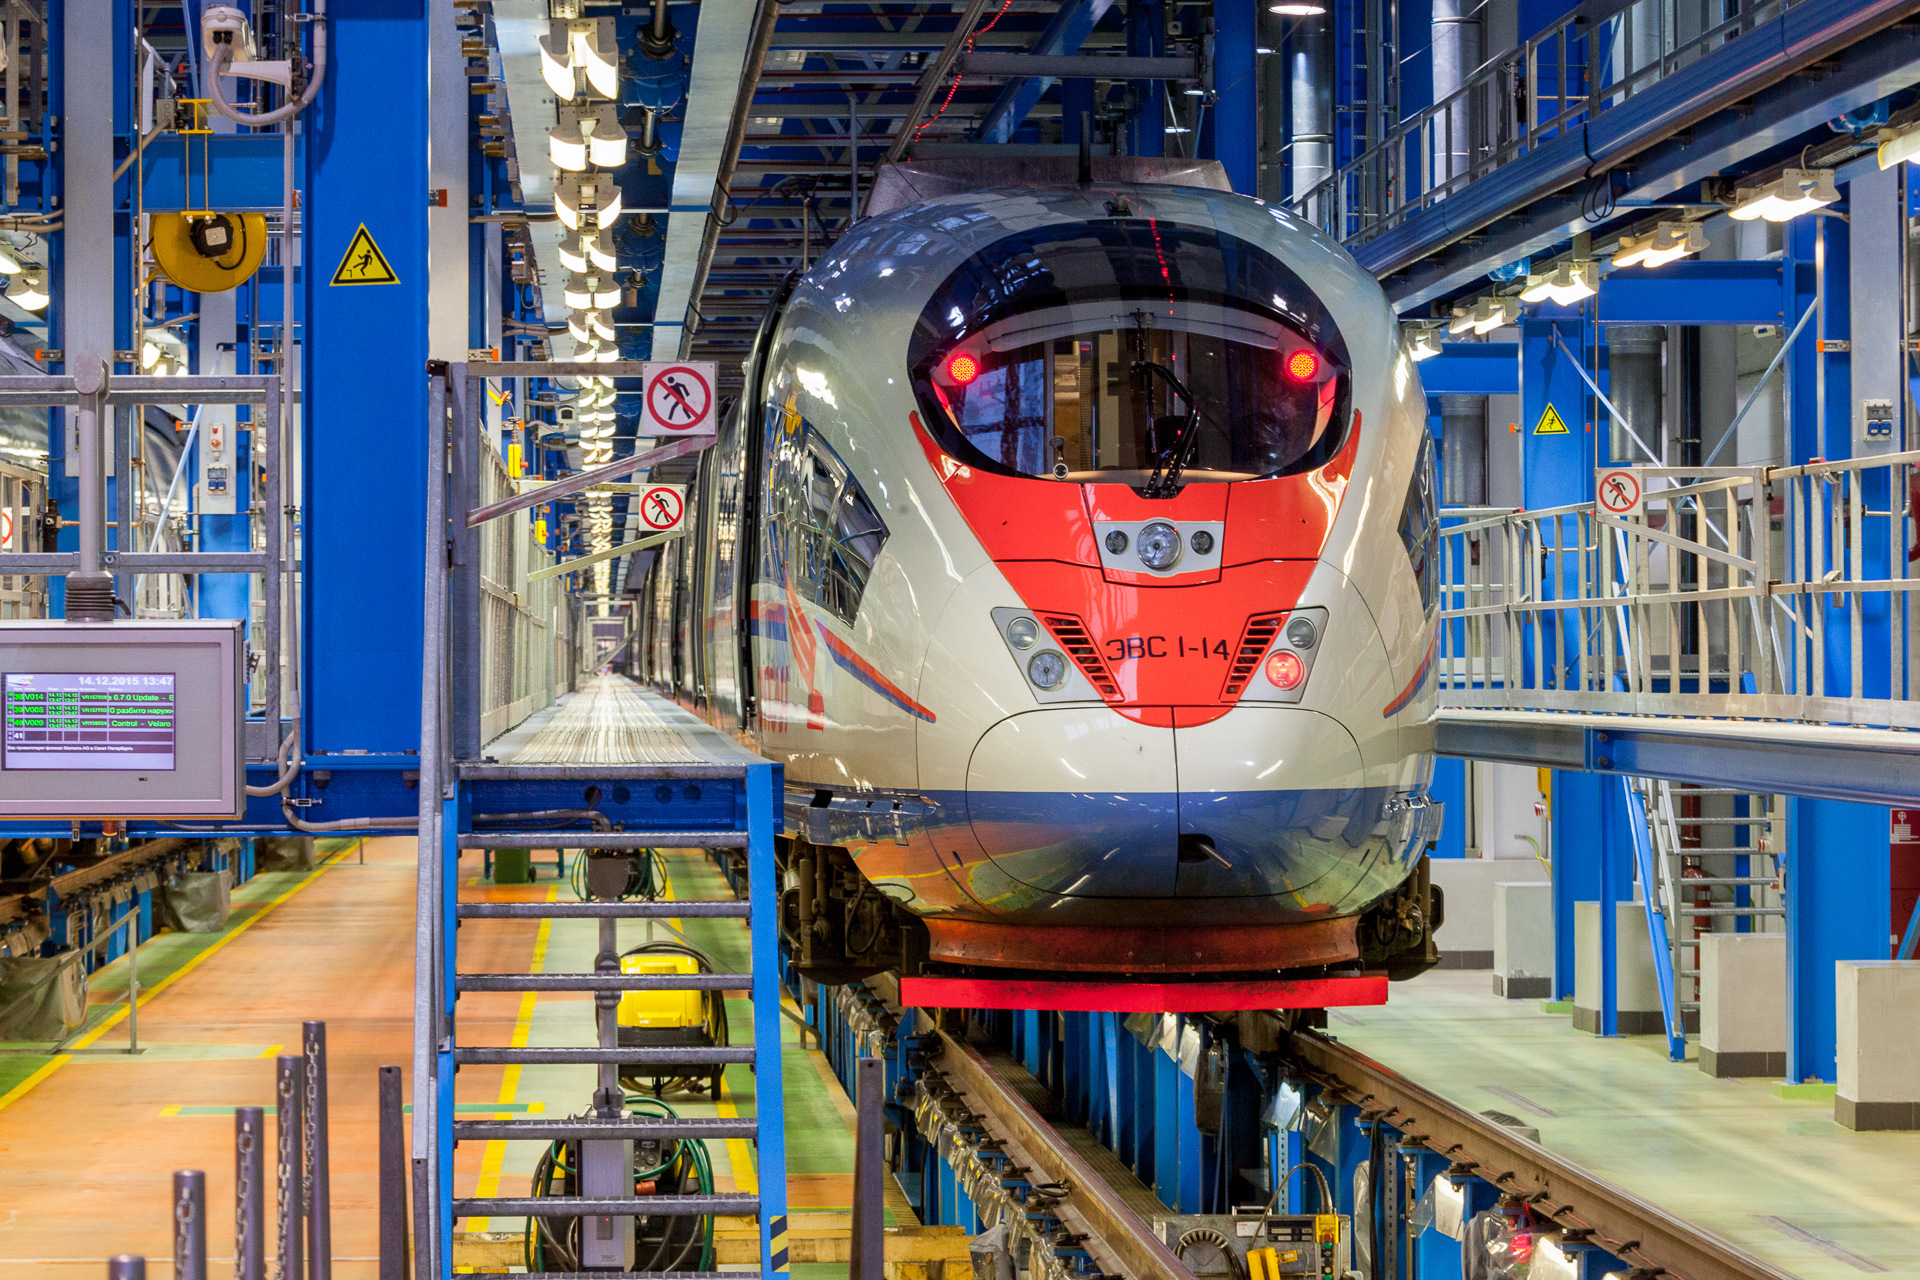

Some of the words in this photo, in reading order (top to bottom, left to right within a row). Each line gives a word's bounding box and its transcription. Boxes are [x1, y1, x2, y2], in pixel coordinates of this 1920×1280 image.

[1105, 636, 1167, 661] ЭВС
[1178, 635, 1231, 661] 1-14
[78, 676, 139, 686] 14.12.2015
[142, 676, 173, 686] 13:47
